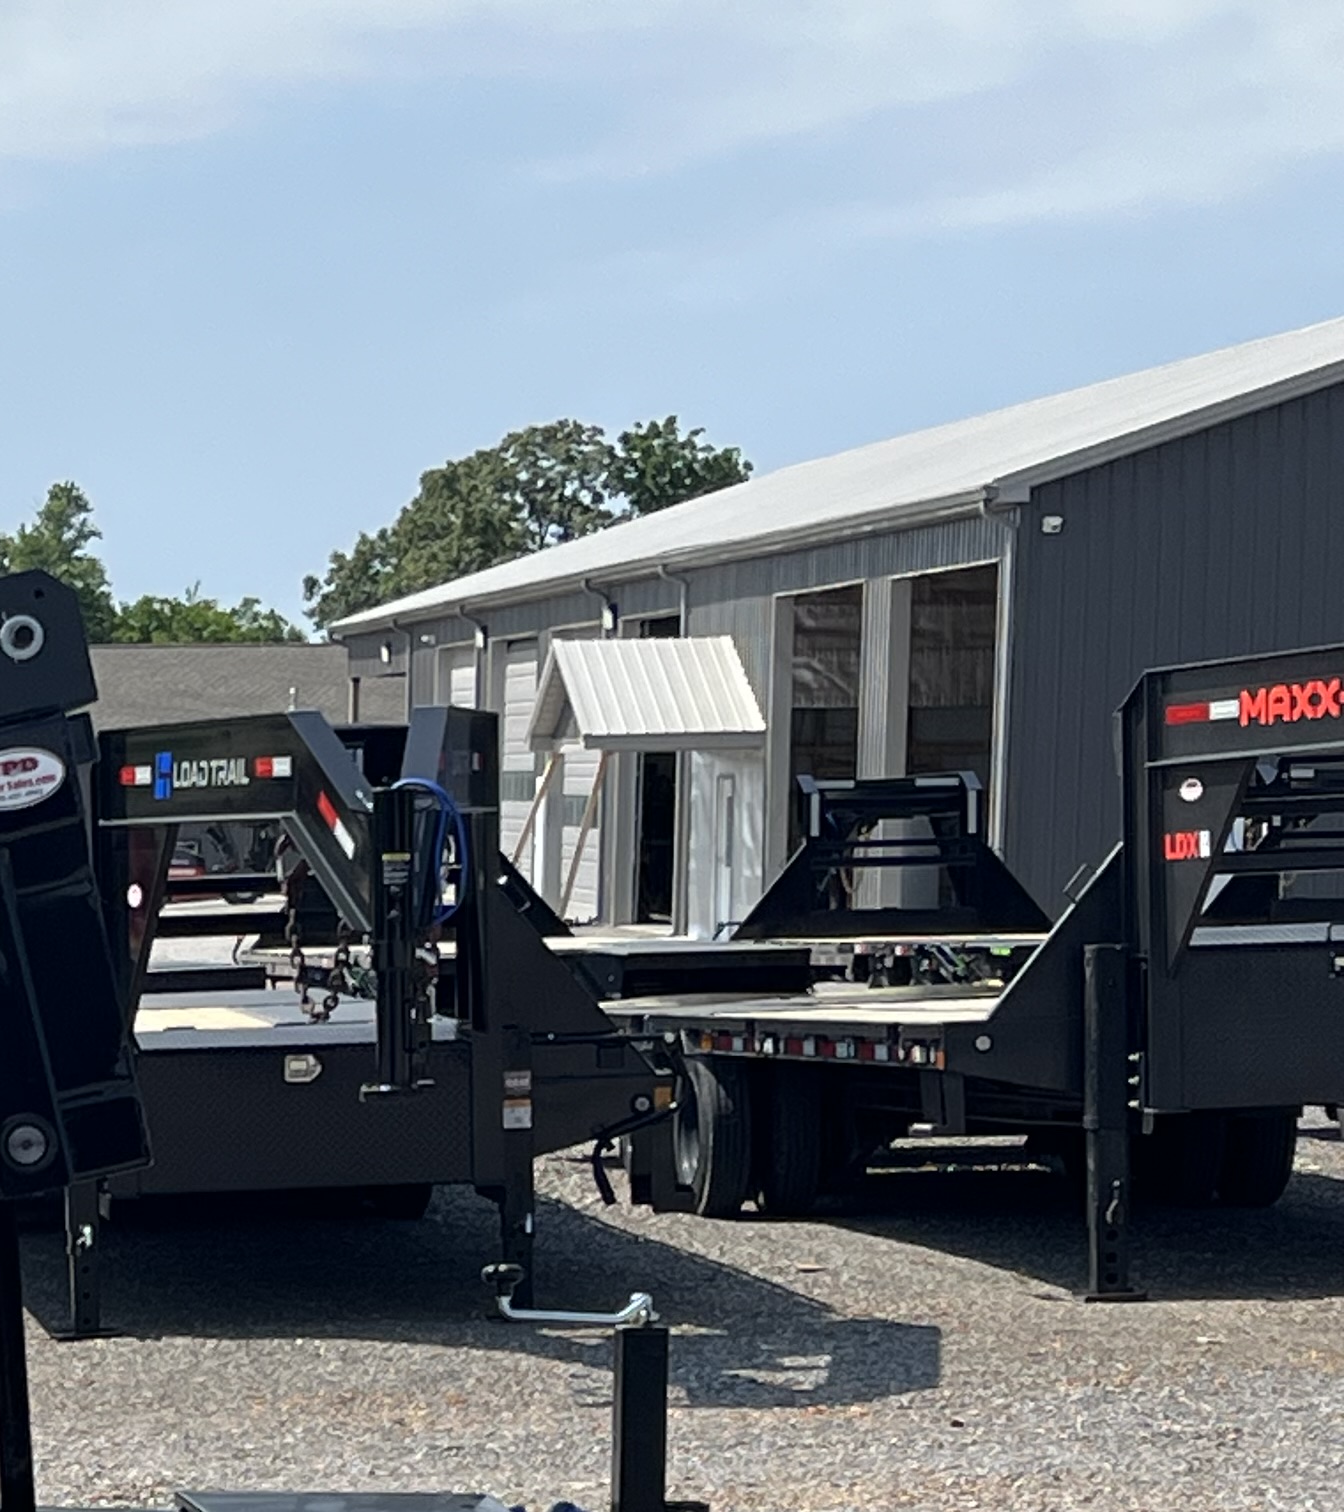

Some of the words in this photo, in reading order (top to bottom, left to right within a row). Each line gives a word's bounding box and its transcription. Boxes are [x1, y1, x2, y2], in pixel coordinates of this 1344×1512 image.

[172, 759, 209, 789] LOAD
[210, 757, 250, 787] TRAIL
[1164, 831, 1200, 861] LDX
